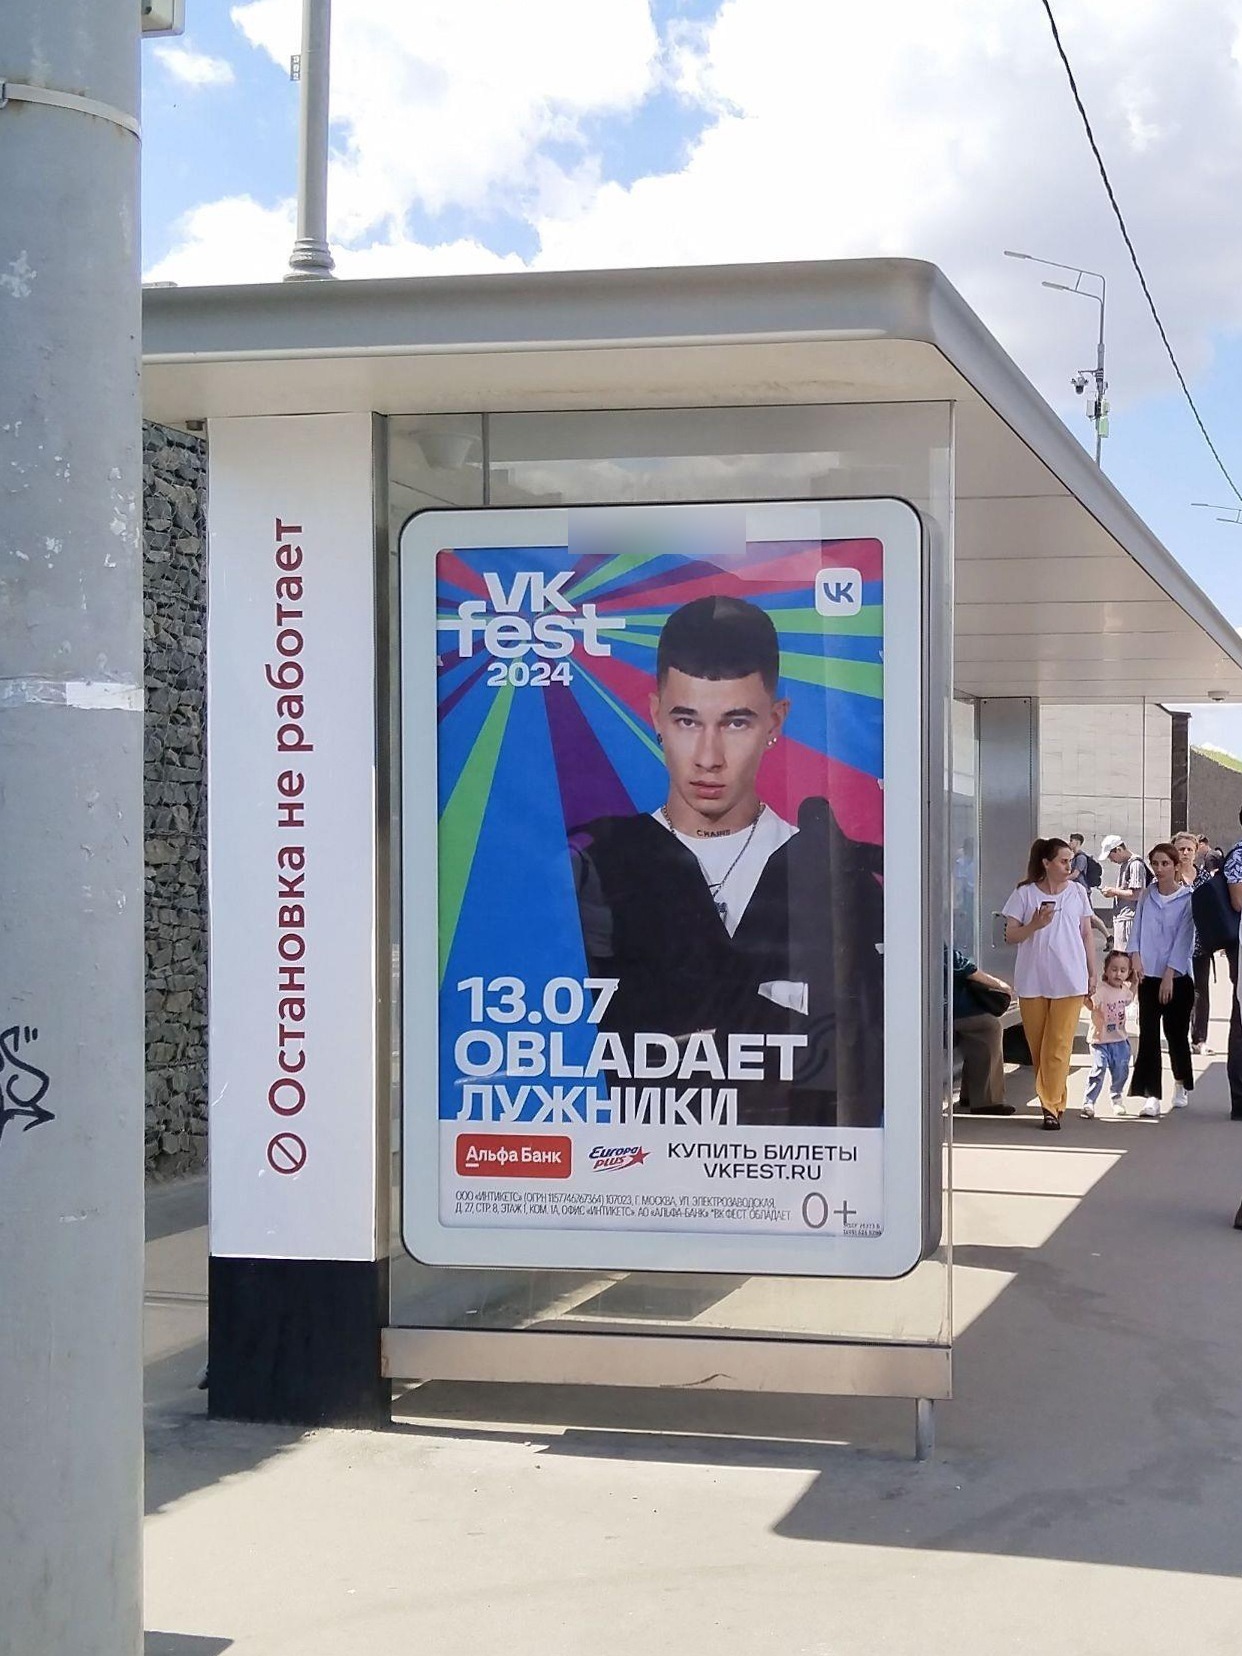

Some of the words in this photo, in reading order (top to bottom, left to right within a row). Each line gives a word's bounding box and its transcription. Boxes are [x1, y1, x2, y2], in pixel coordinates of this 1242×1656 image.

[483, 571, 577, 613] VK
[823, 582, 855, 603] VK
[265, 517, 314, 752] работает
[437, 600, 626, 659] fest
[487, 662, 573, 687] 2024
[277, 769, 305, 828] не
[268, 846, 306, 1117] Остановка
[457, 976, 620, 1025] 13.07
[454, 1030, 808, 1081] OBLADAET
[456, 1084, 738, 1125] ЛУЖНИКИ
[465, 1146, 518, 1167] Альфа
[521, 1147, 562, 1163] Банк
[668, 1143, 757, 1159] КУПИТЬ
[764, 1144, 857, 1161] БИЛЕТЫ
[704, 1163, 821, 1180] VKFEST.RU
[456, 1190, 473, 1200] ООО
[802, 1192, 857, 1228] 0+
